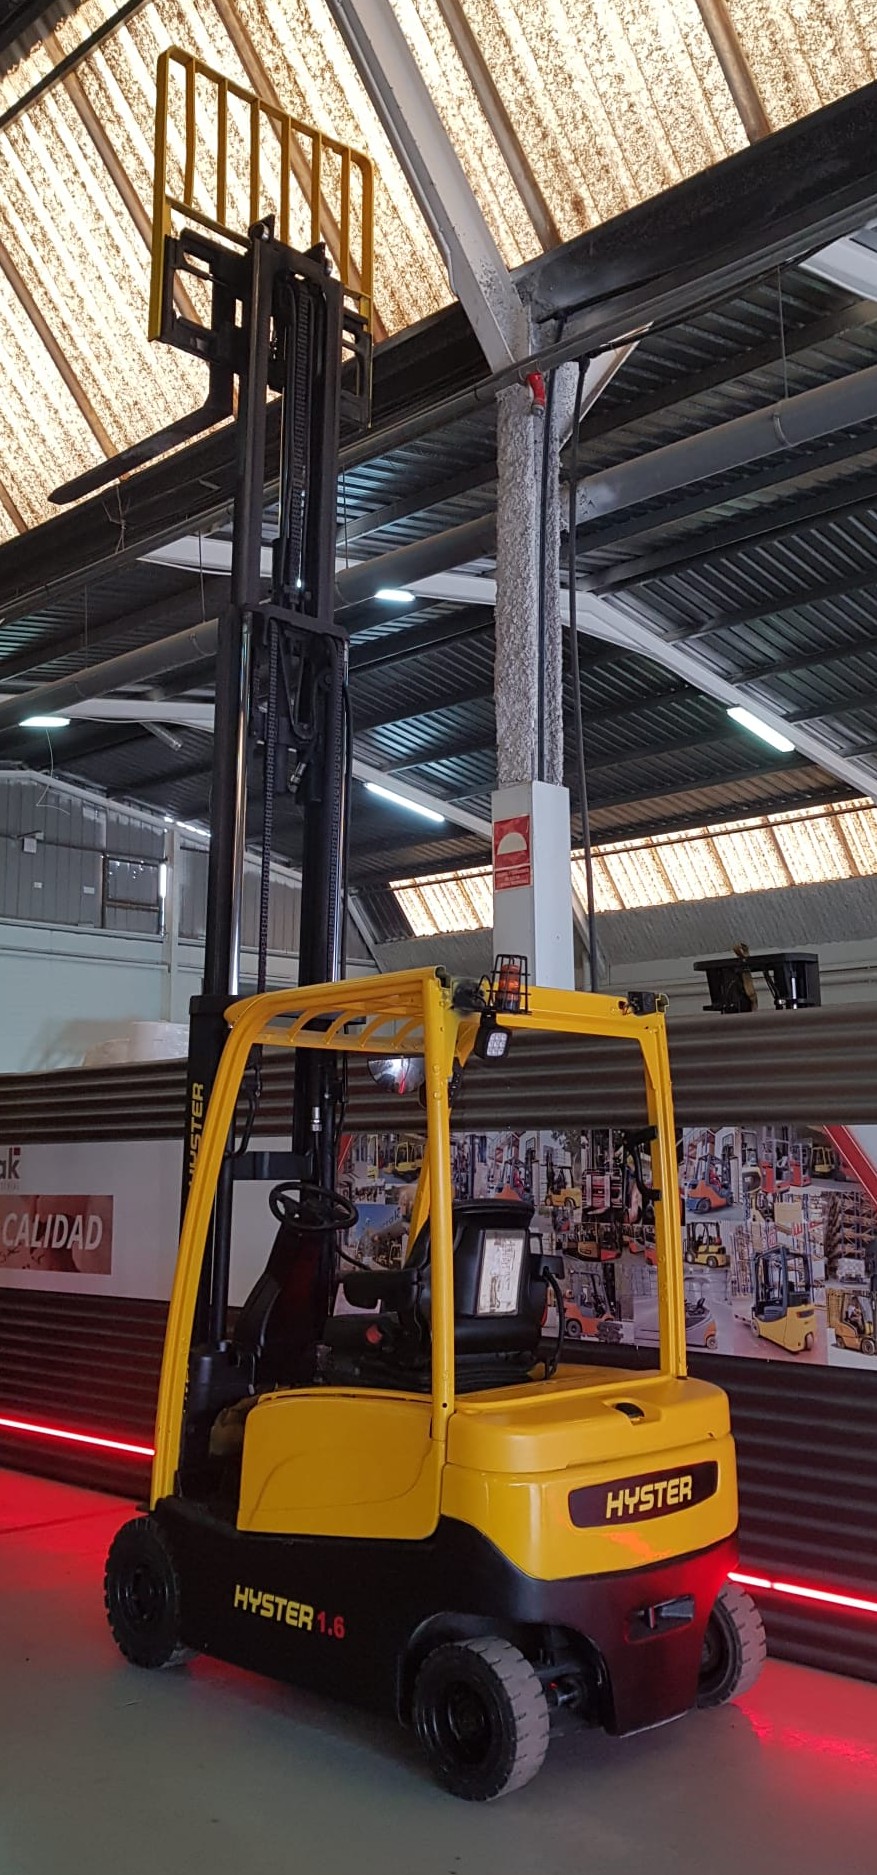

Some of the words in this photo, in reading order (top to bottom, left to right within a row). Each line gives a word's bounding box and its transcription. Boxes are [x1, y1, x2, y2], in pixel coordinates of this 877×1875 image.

[2, 1212, 103, 1251] CALIDAD
[605, 1475, 693, 1519] HYSTER
[233, 1584, 314, 1631] HYSTER
[317, 1611, 346, 1639] 1.6
